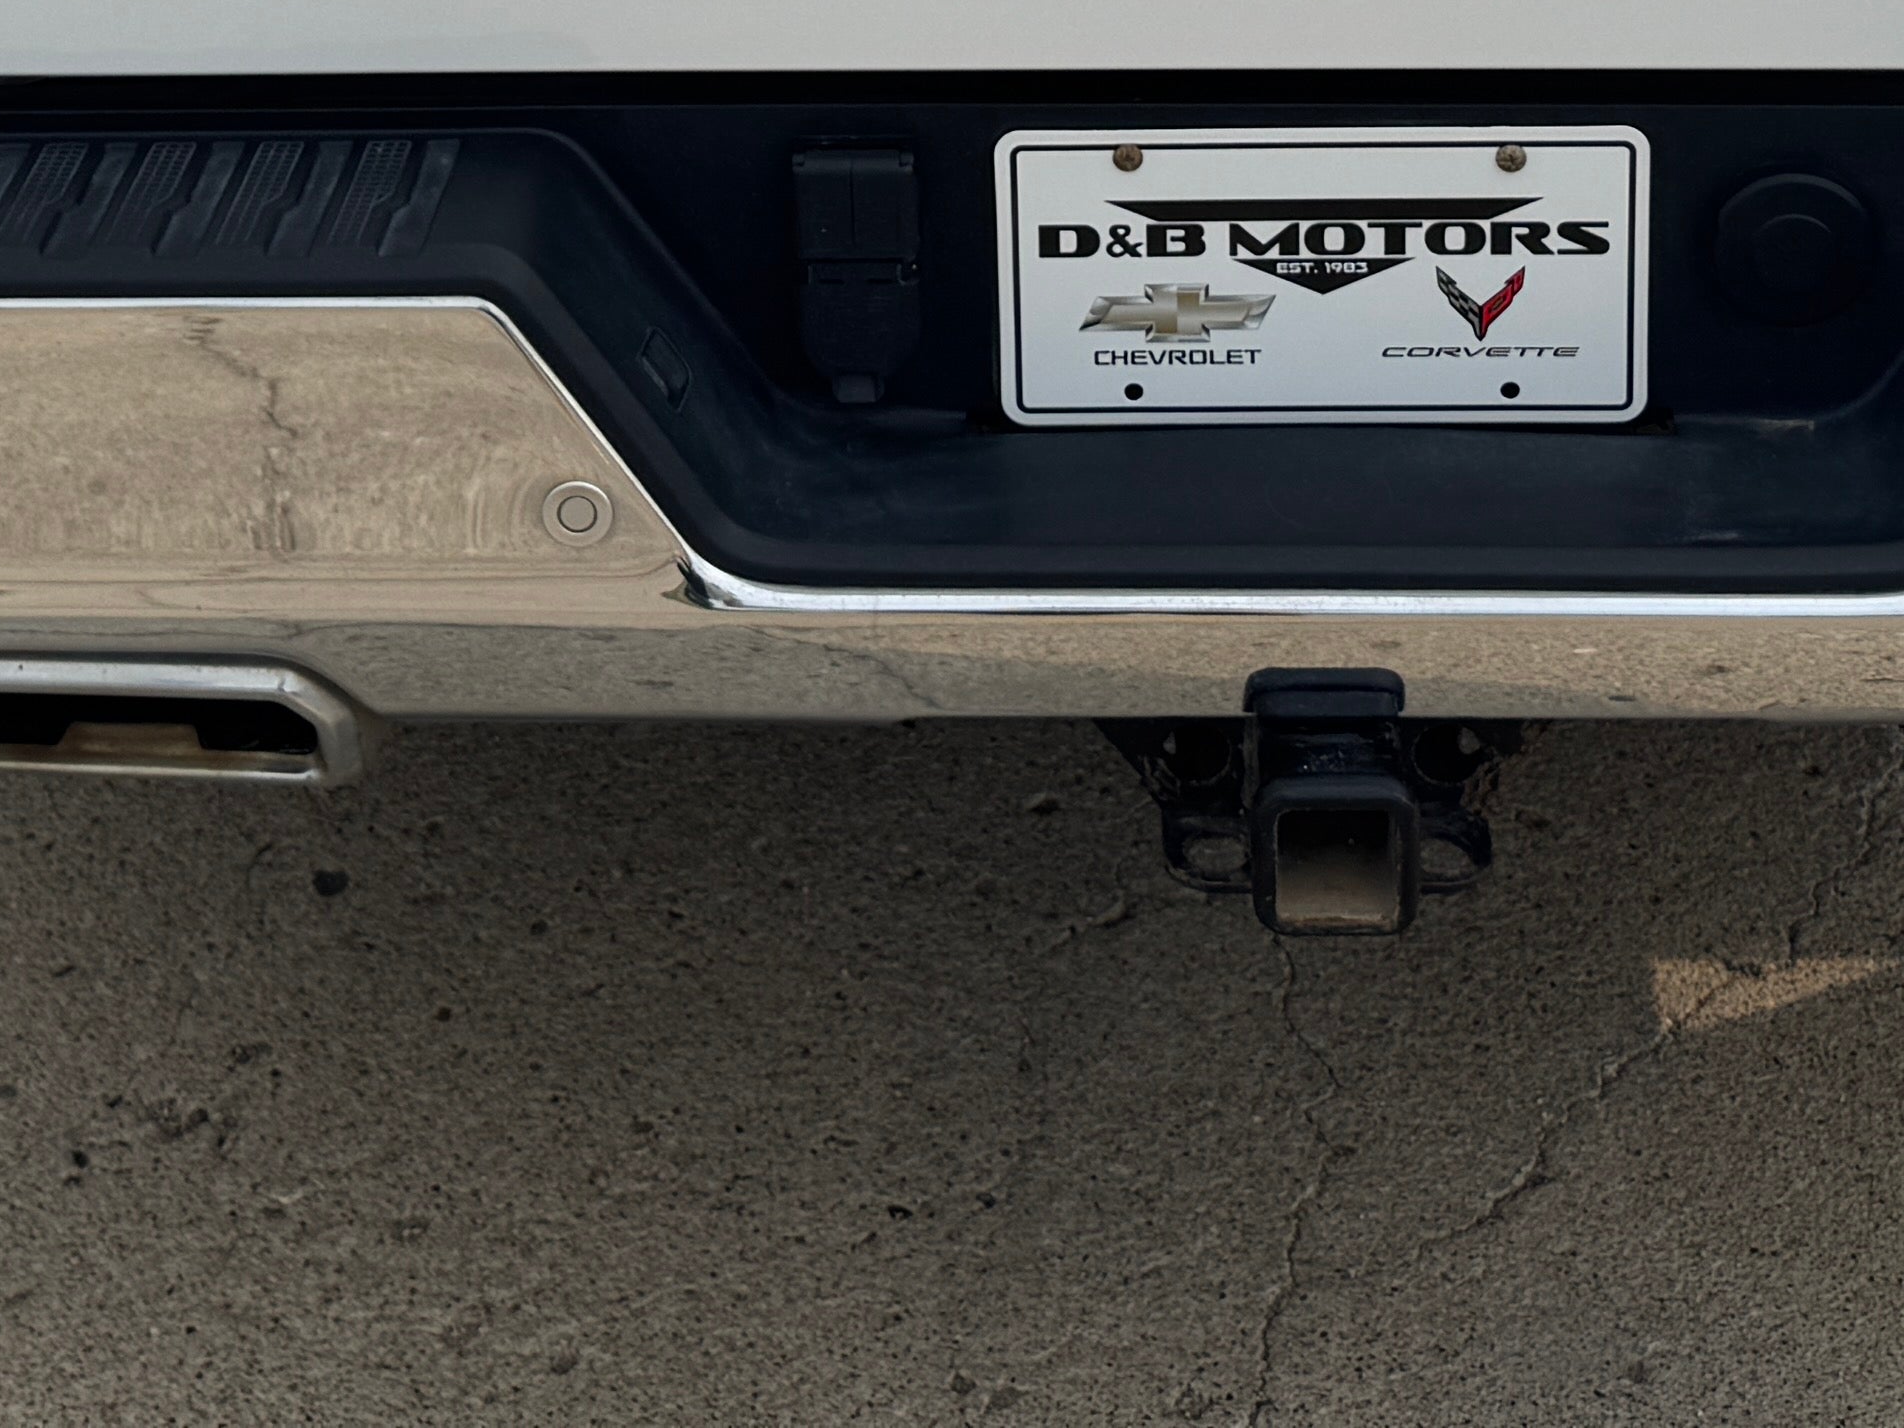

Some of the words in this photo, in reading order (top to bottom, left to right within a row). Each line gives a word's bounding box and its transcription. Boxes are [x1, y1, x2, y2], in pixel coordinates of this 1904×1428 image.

[1037, 222, 1206, 259] D&B
[1229, 219, 1611, 257] MOTORS
[1276, 261, 1319, 274] EST.
[1324, 261, 1369, 274] 1983
[1093, 348, 1262, 366] CHEVROLET
[1381, 346, 1581, 358] CORVETTE
